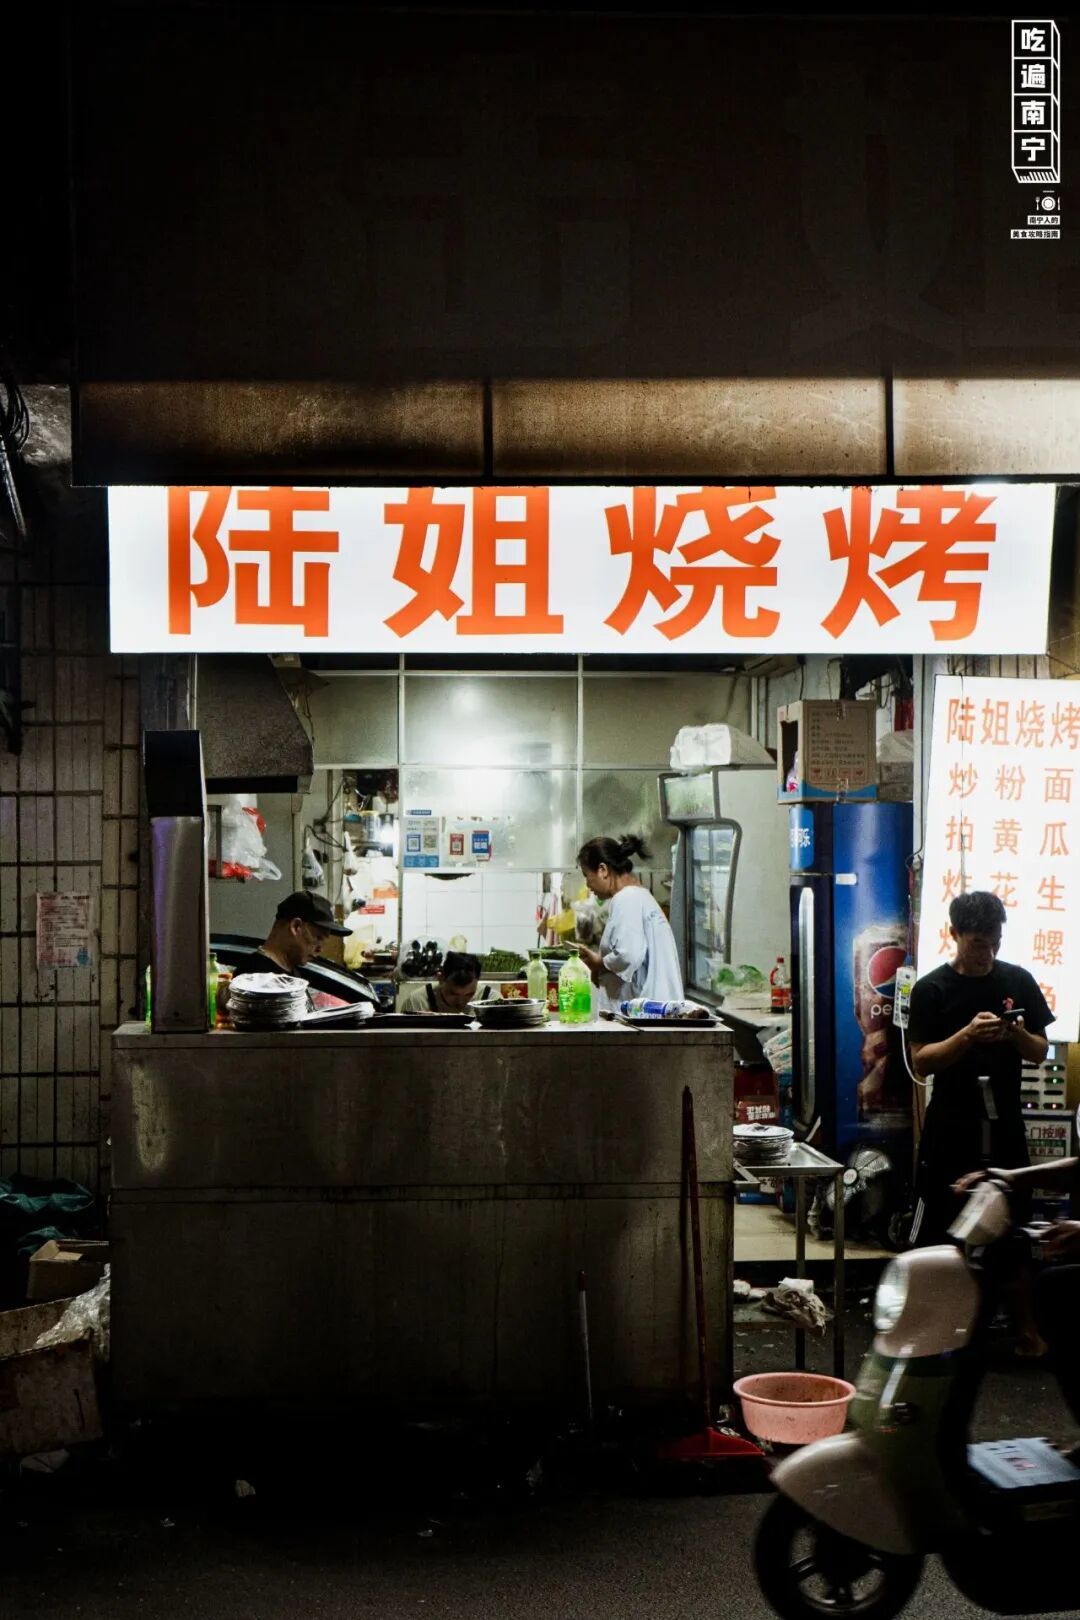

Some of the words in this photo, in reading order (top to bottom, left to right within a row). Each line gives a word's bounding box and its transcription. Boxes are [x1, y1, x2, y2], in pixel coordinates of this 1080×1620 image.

[168, 485, 998, 641] 陆姐烧烤
[946, 696, 1080, 750] 陆姐烧烤
[948, 762, 1074, 803] 炒粉面
[945, 815, 1069, 856] 拍黄瓜
